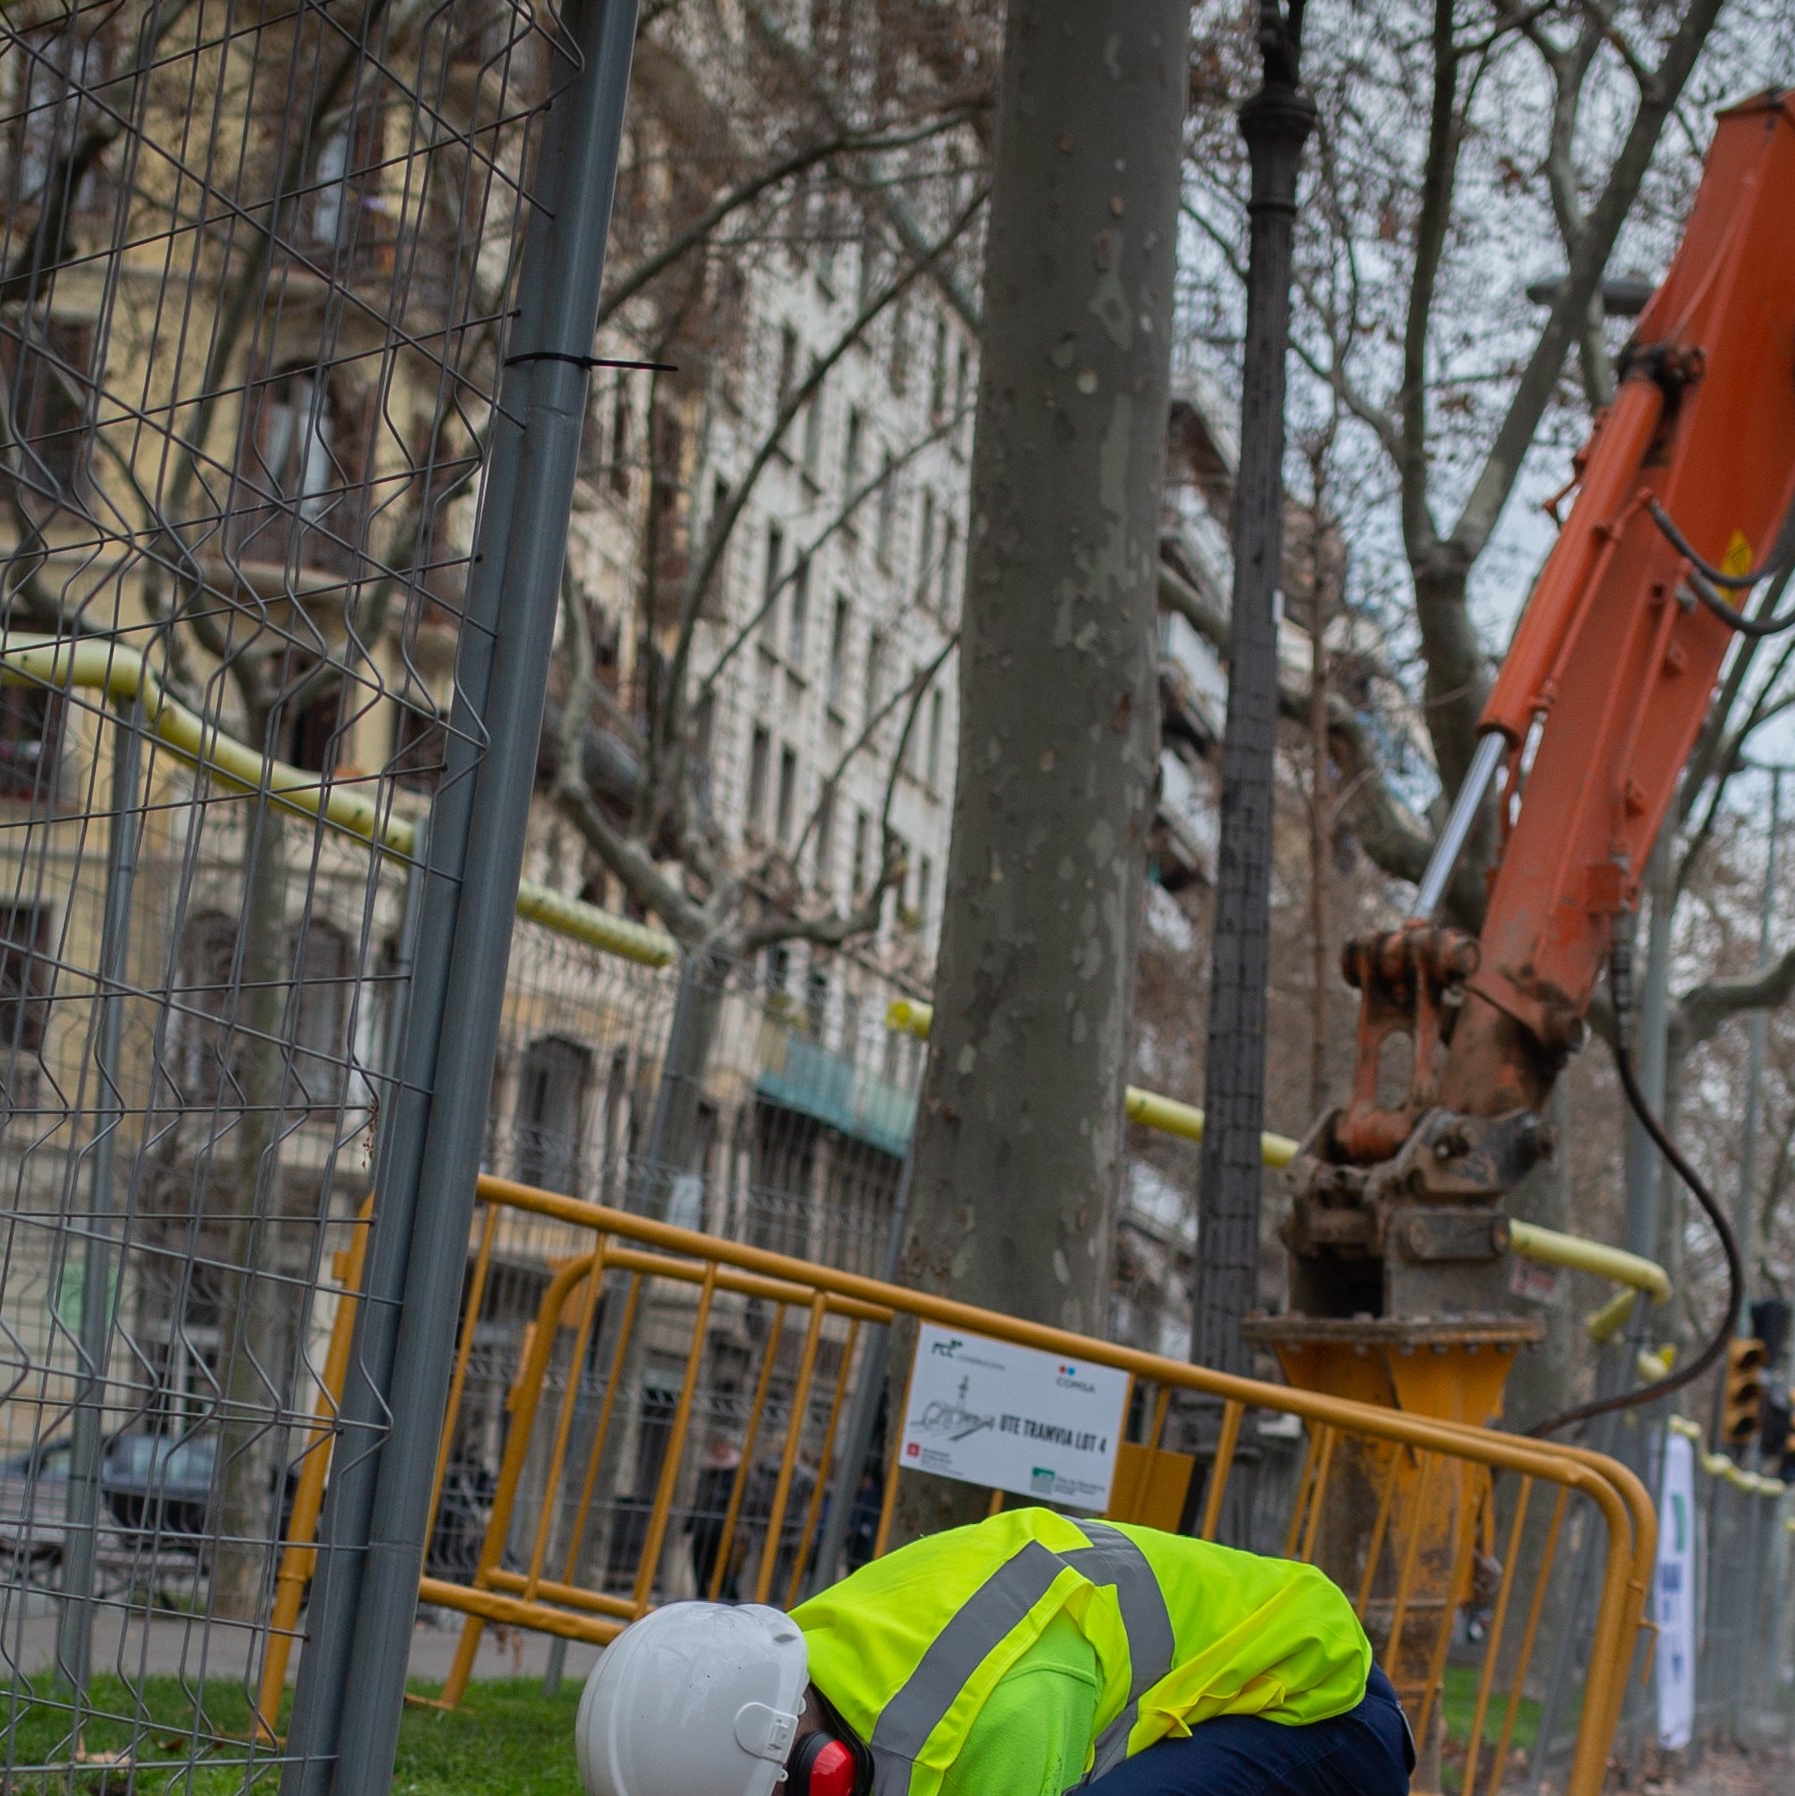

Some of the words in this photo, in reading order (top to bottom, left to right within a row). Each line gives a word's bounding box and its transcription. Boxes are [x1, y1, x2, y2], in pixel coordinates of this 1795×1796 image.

[1000, 1413, 1021, 1436] UTE
[1075, 1431, 1097, 1452] LOT
[1099, 1437, 1107, 1455] 4
